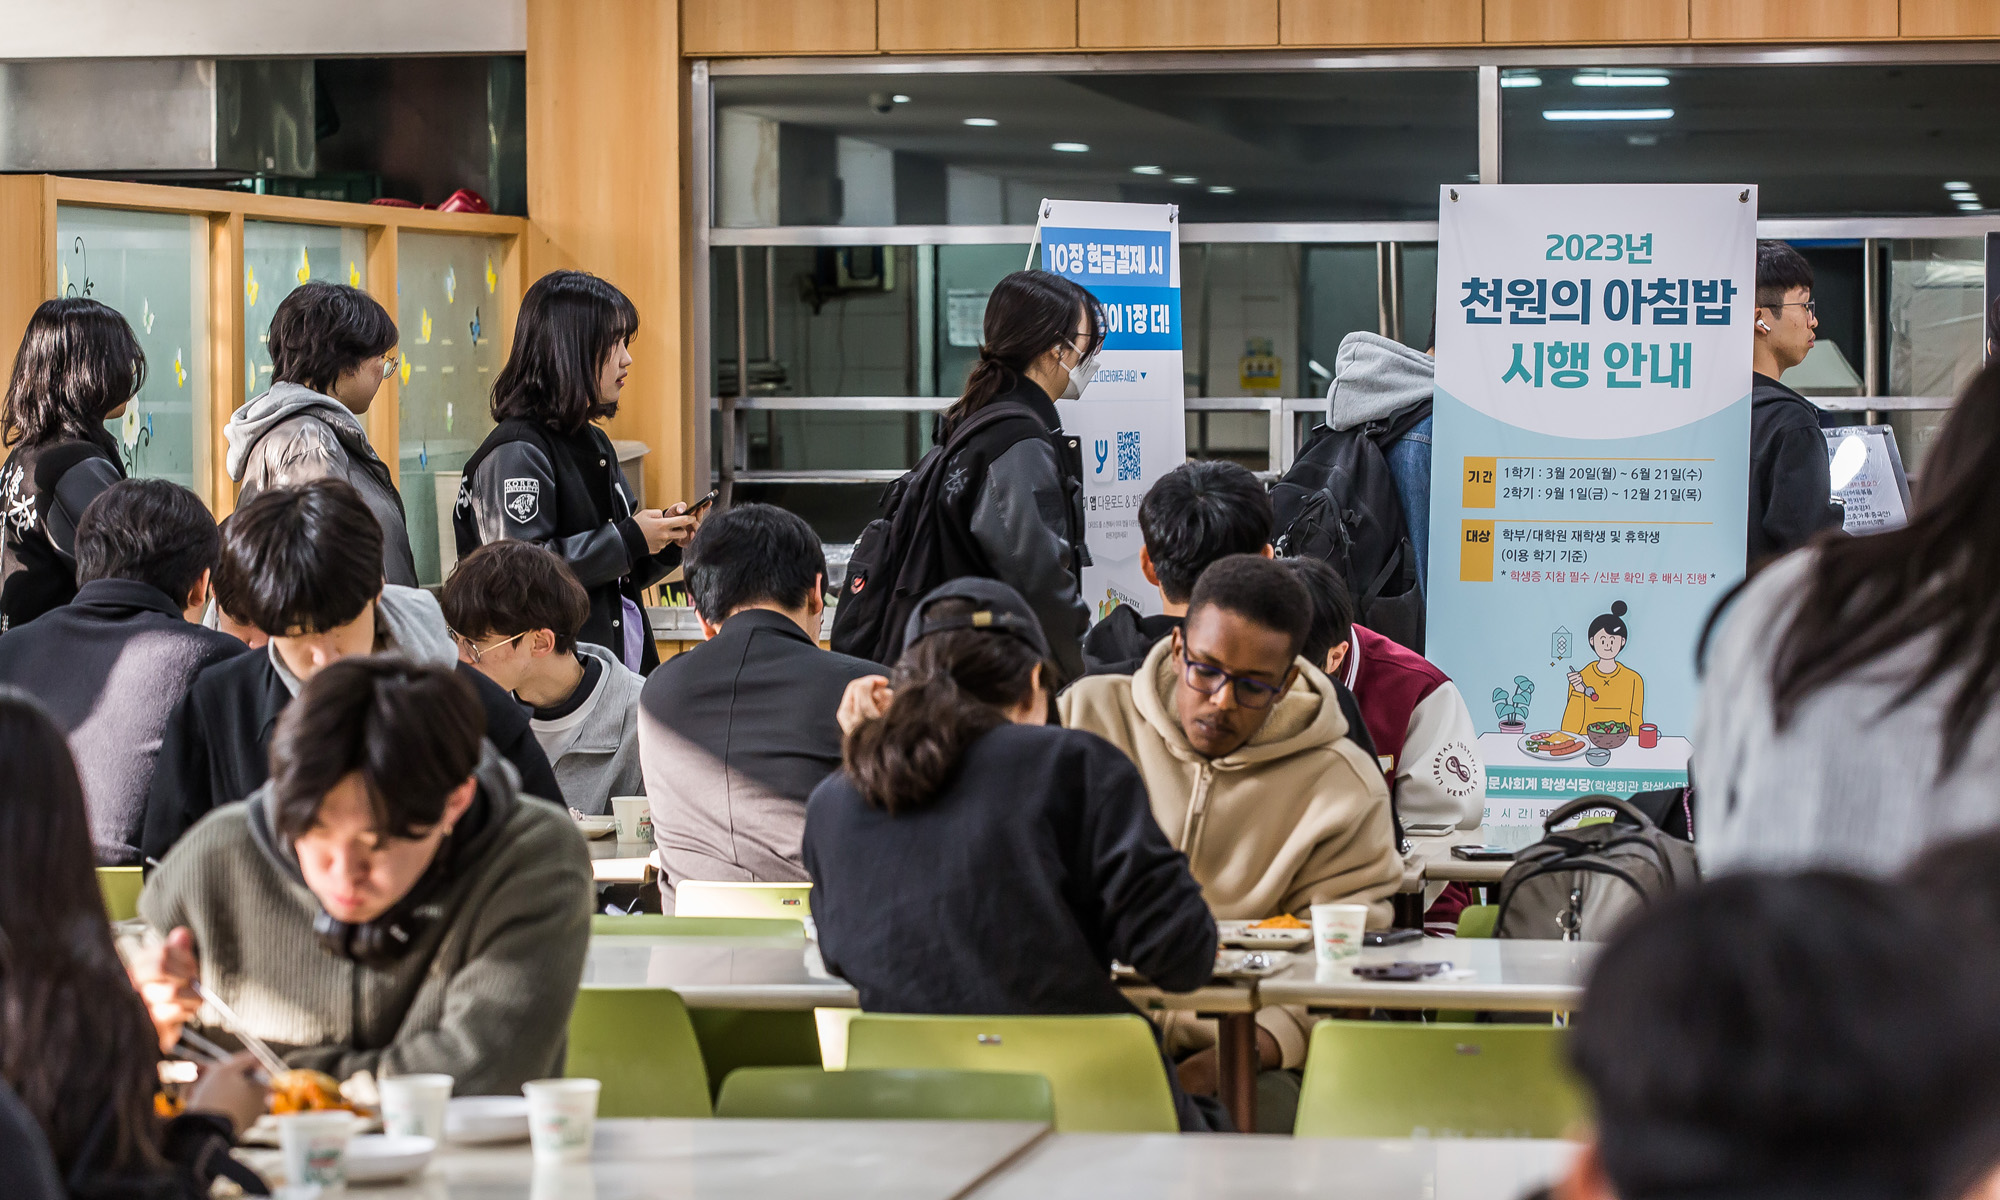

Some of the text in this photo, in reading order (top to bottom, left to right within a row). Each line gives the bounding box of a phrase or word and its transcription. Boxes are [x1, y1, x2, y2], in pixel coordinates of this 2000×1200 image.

[1545, 232, 1653, 265] 2023년
[1049, 242, 1163, 275] 10장 현금결제 시
[1459, 276, 1738, 326] 천원의 아침밥
[1125, 304, 1148, 335] 1장
[1501, 340, 1693, 389] 시행 안내
[1504, 466, 1535, 480] 1학기
[1545, 466, 1565, 481] 3월
[1568, 466, 1617, 481] 20일(월)
[1630, 467, 1651, 481] 6월
[1654, 467, 1703, 482] 21일(수)
[1089, 495, 1097, 511] 앱
[1097, 495, 1124, 511] 다운로드
[1125, 495, 1131, 509] &
[1502, 486, 1534, 500] 2학기
[1545, 486, 1565, 501] 9월
[1569, 486, 1609, 501] 1일(금)
[1623, 487, 1650, 502] 12월
[1653, 487, 1702, 502] 21일(목)
[1465, 529, 1491, 543] 대상
[1502, 528, 1660, 544] 학부/대학원 재학생 및 휴학생
[1501, 548, 1588, 564] (이용 학기 기준)
[1510, 569, 1542, 583] 학생증
[1544, 570, 1567, 583] 지참
[1569, 571, 1591, 584] 필수
[1623, 571, 1645, 584] 확인
[1647, 572, 1659, 585] 후
[1661, 572, 1684, 585] 배식
[1686, 572, 1708, 586] 진행
[1433, 742, 1454, 786] LIBERTAS
[1446, 779, 1478, 798] VERITAS
